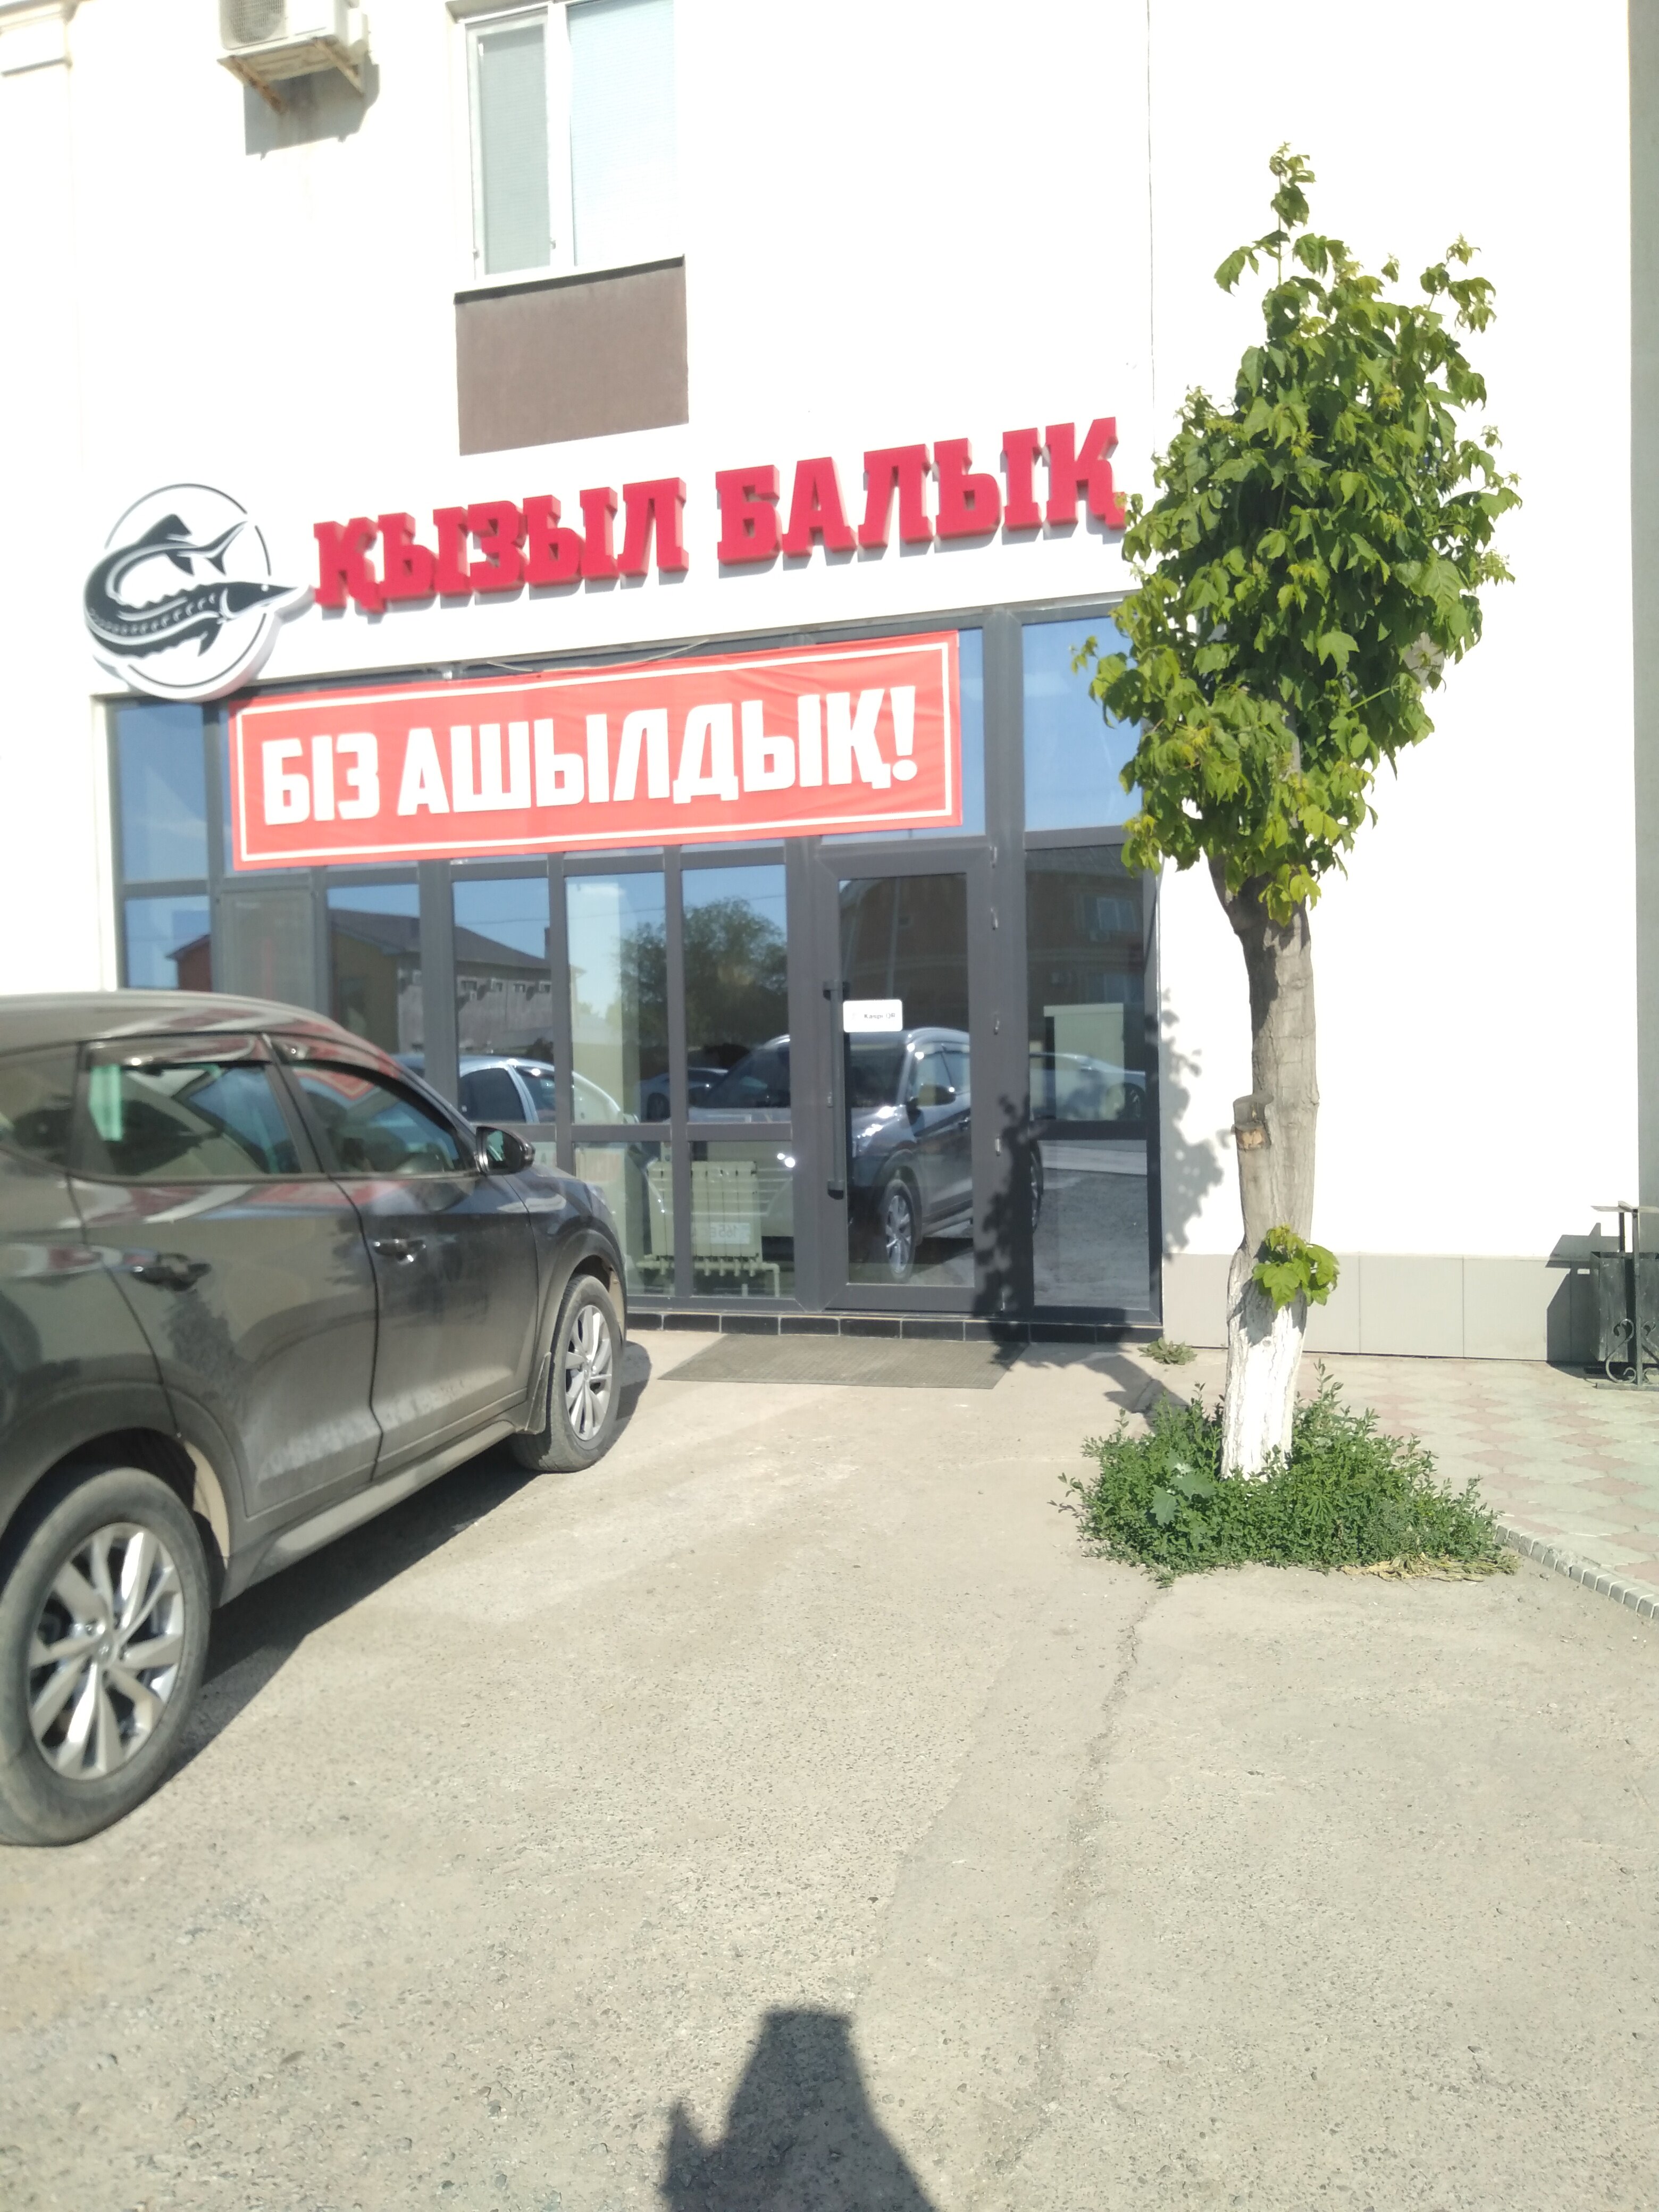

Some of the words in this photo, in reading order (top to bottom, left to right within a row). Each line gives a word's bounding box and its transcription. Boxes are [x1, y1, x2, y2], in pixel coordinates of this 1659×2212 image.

[314, 477, 689, 614] ҚЫЗЫЛ
[716, 416, 1126, 565] БАЛЫҚ
[262, 732, 380, 825] БІЗ
[397, 685, 918, 816] АШЫЛДЫҚ!
